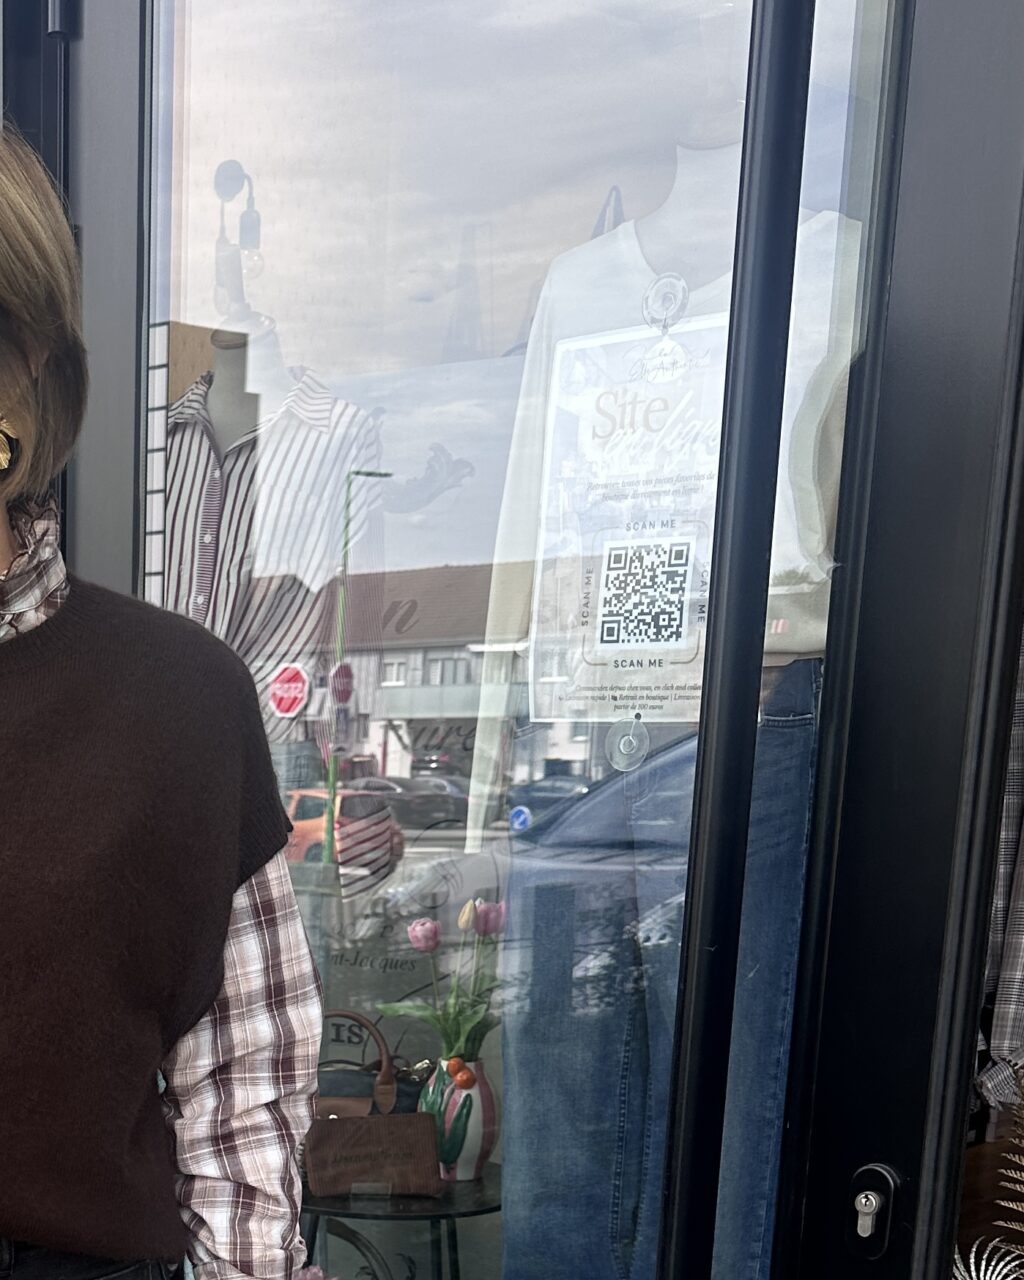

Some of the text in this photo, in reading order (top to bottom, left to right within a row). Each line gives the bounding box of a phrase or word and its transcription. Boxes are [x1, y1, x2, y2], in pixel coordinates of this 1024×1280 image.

[592, 388, 670, 440] Site
[625, 519, 677, 532] SCAN ME
[581, 567, 594, 628] SCAN ME
[697, 561, 710, 624] SCAN ME
[613, 658, 664, 668] SCAN ME
[330, 950, 417, 974] nt-Jacques
[331, 1022, 364, 1045] IS
